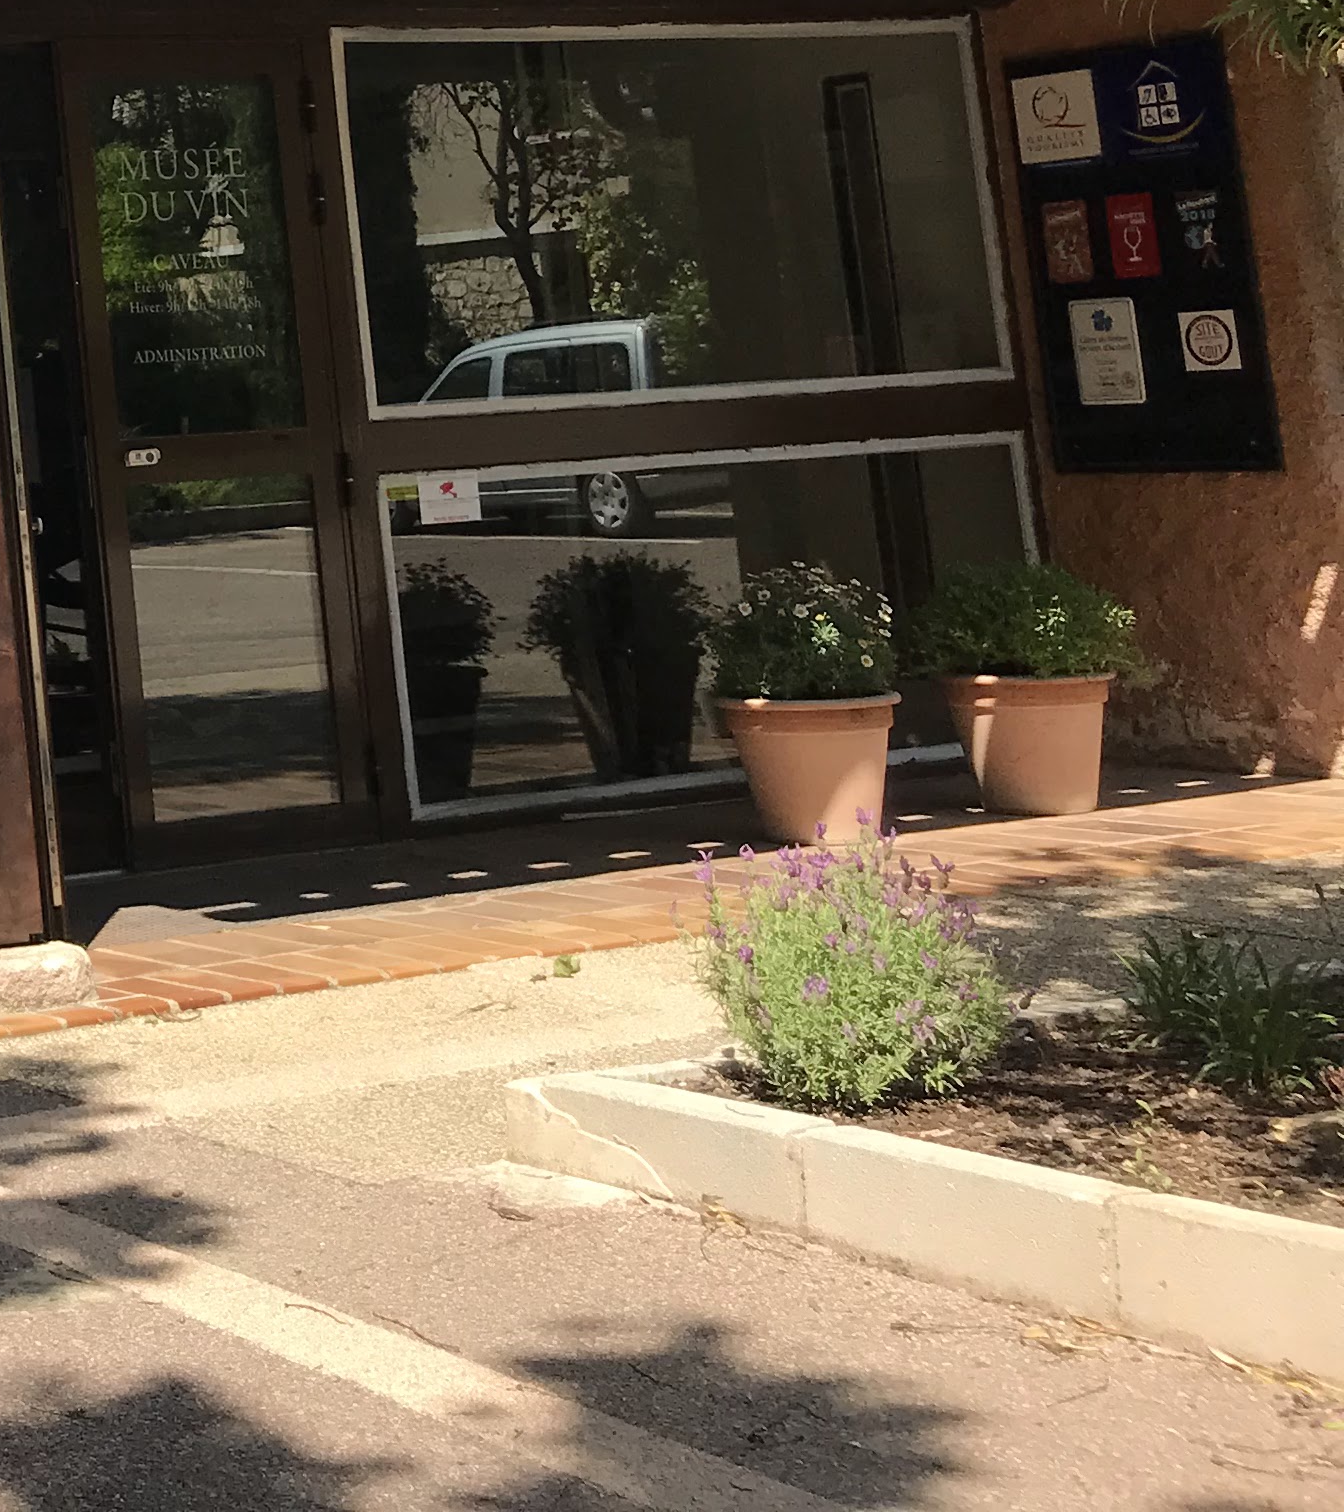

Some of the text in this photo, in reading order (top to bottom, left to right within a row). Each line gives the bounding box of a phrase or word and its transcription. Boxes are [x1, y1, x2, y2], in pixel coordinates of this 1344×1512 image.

[119, 141, 247, 181] MUSÉE
[120, 188, 248, 223] DU VIN
[153, 253, 229, 271] CAVEAU
[1195, 321, 1221, 336] SITE
[133, 345, 266, 364] ADMINISTRATION
